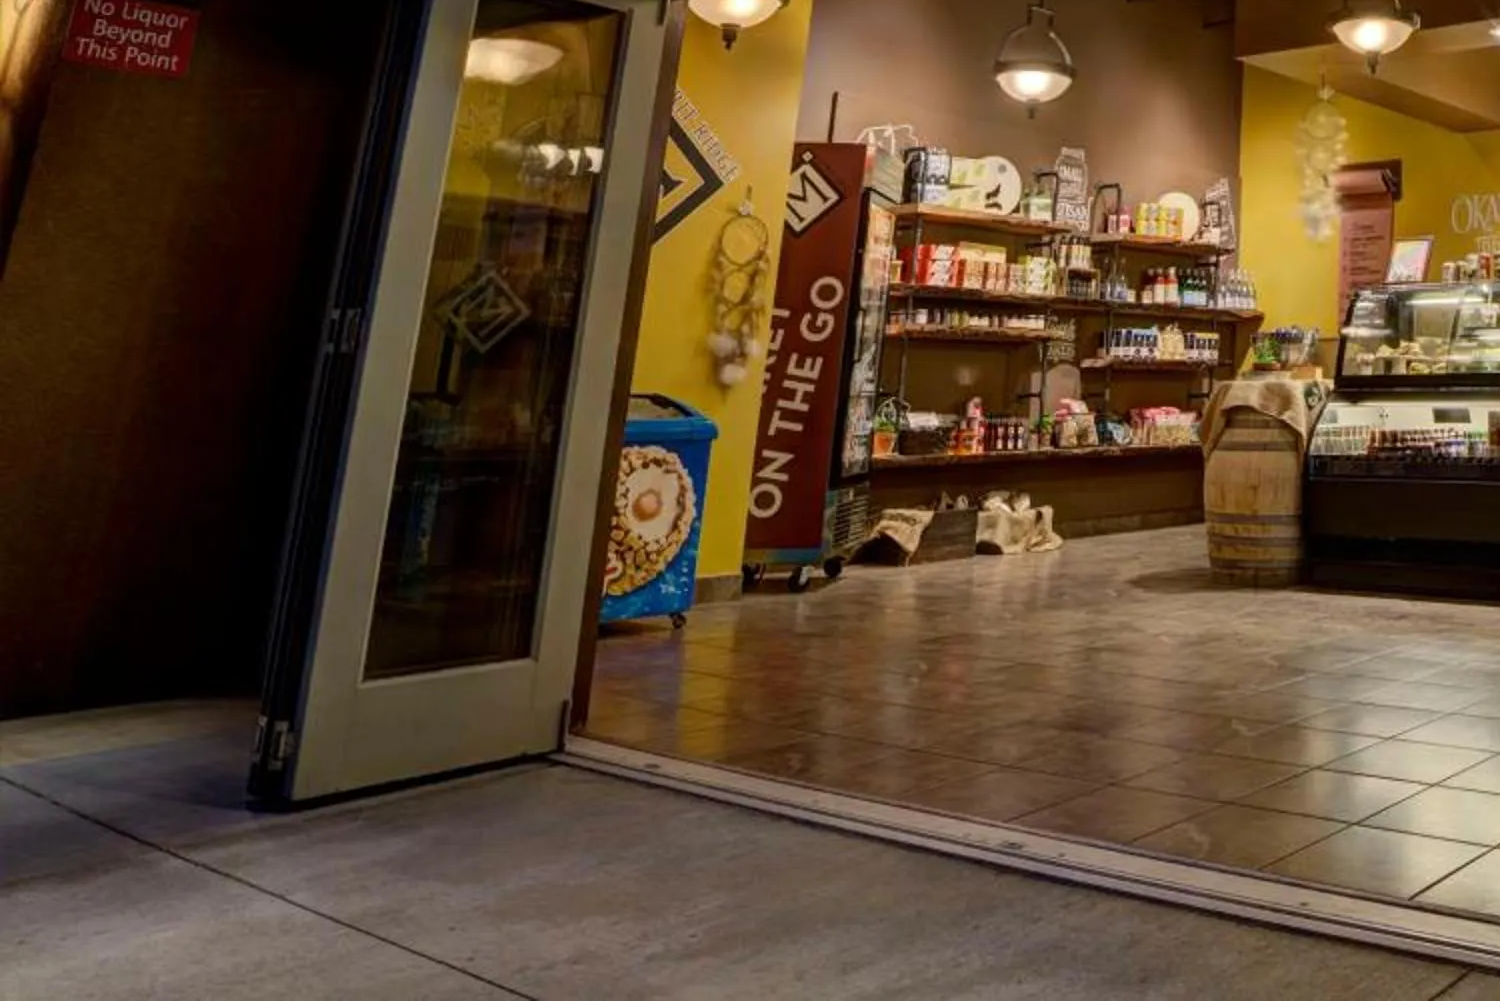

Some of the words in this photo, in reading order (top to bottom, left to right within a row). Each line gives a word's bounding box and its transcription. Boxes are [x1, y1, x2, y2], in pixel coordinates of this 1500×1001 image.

[93, 18, 173, 48] Beyond
[121, 1, 188, 31] Liquor
[76, 36, 118, 61] This
[125, 46, 179, 71] Point
[799, 276, 845, 343] GO
[768, 352, 825, 433] THE
[750, 449, 795, 519] ON
